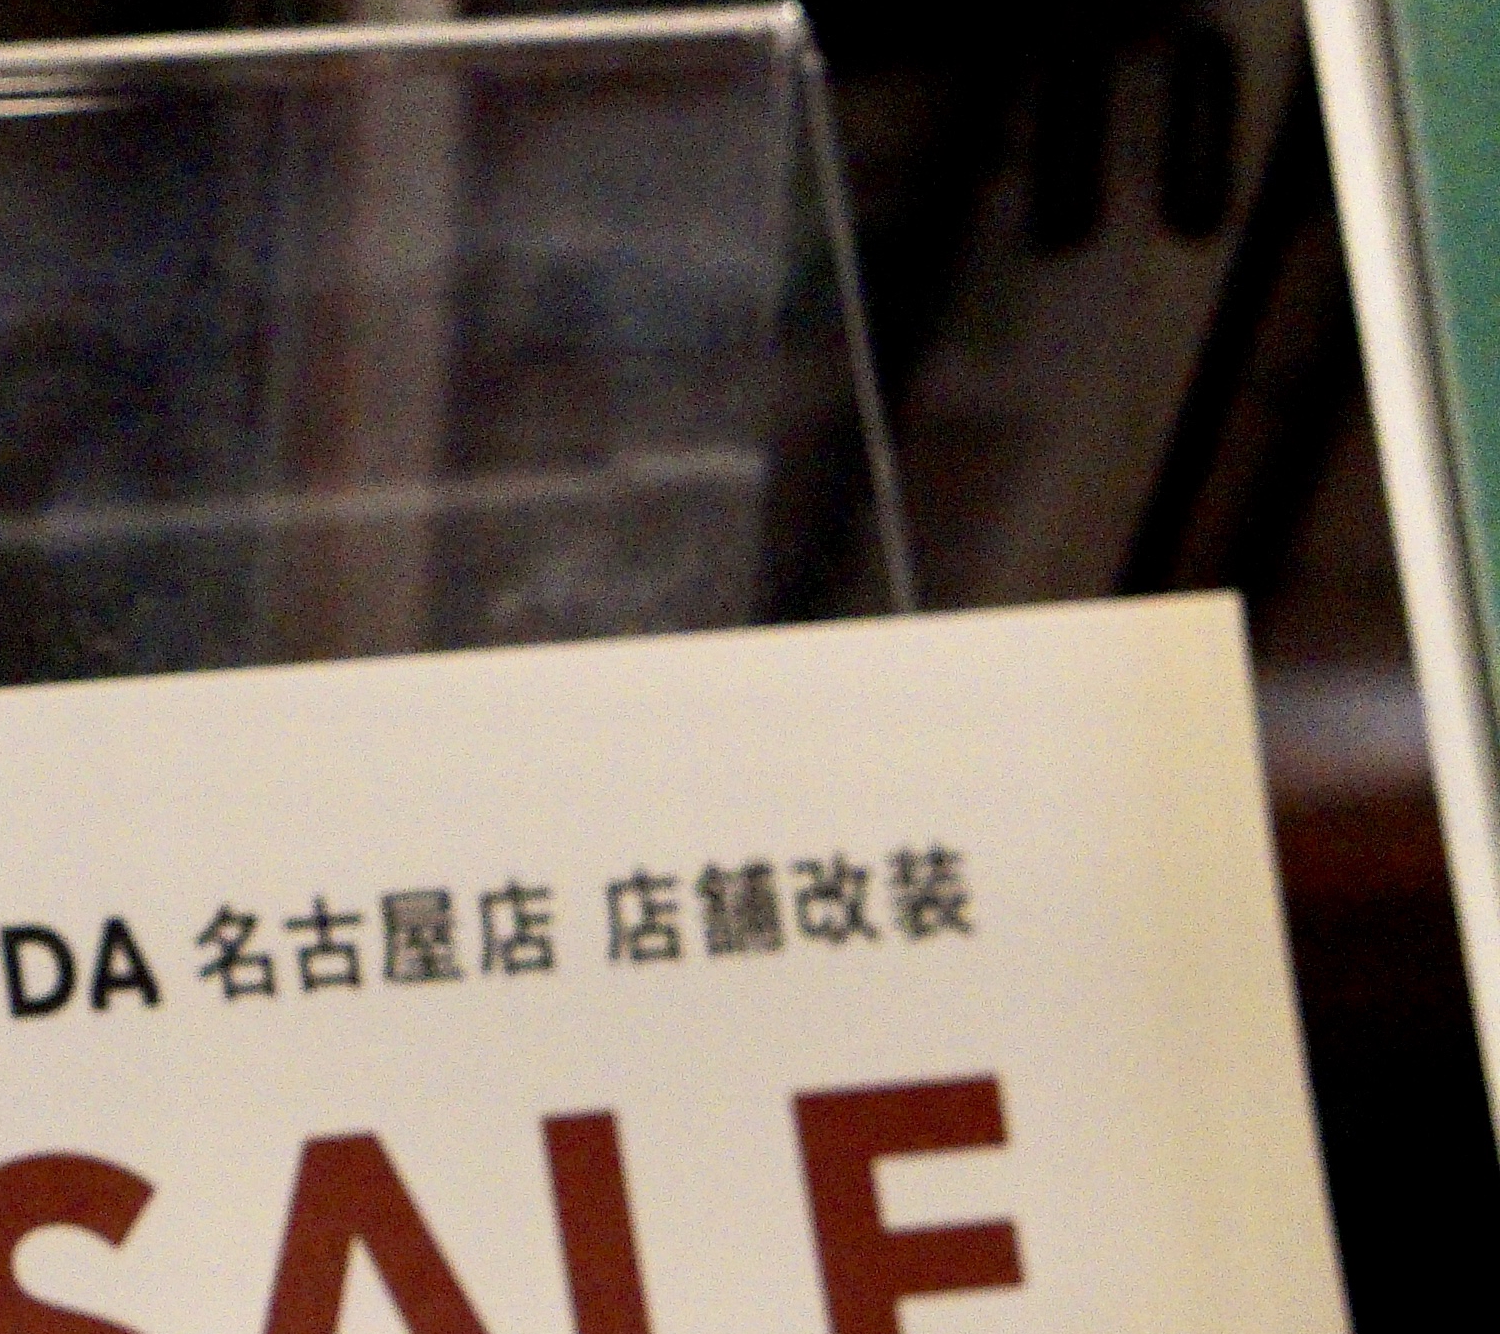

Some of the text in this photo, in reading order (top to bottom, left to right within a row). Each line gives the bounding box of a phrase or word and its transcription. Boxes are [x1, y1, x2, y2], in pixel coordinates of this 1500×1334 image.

[194, 879, 560, 1003] 名古屋店
[604, 845, 974, 966] 店舗改装
